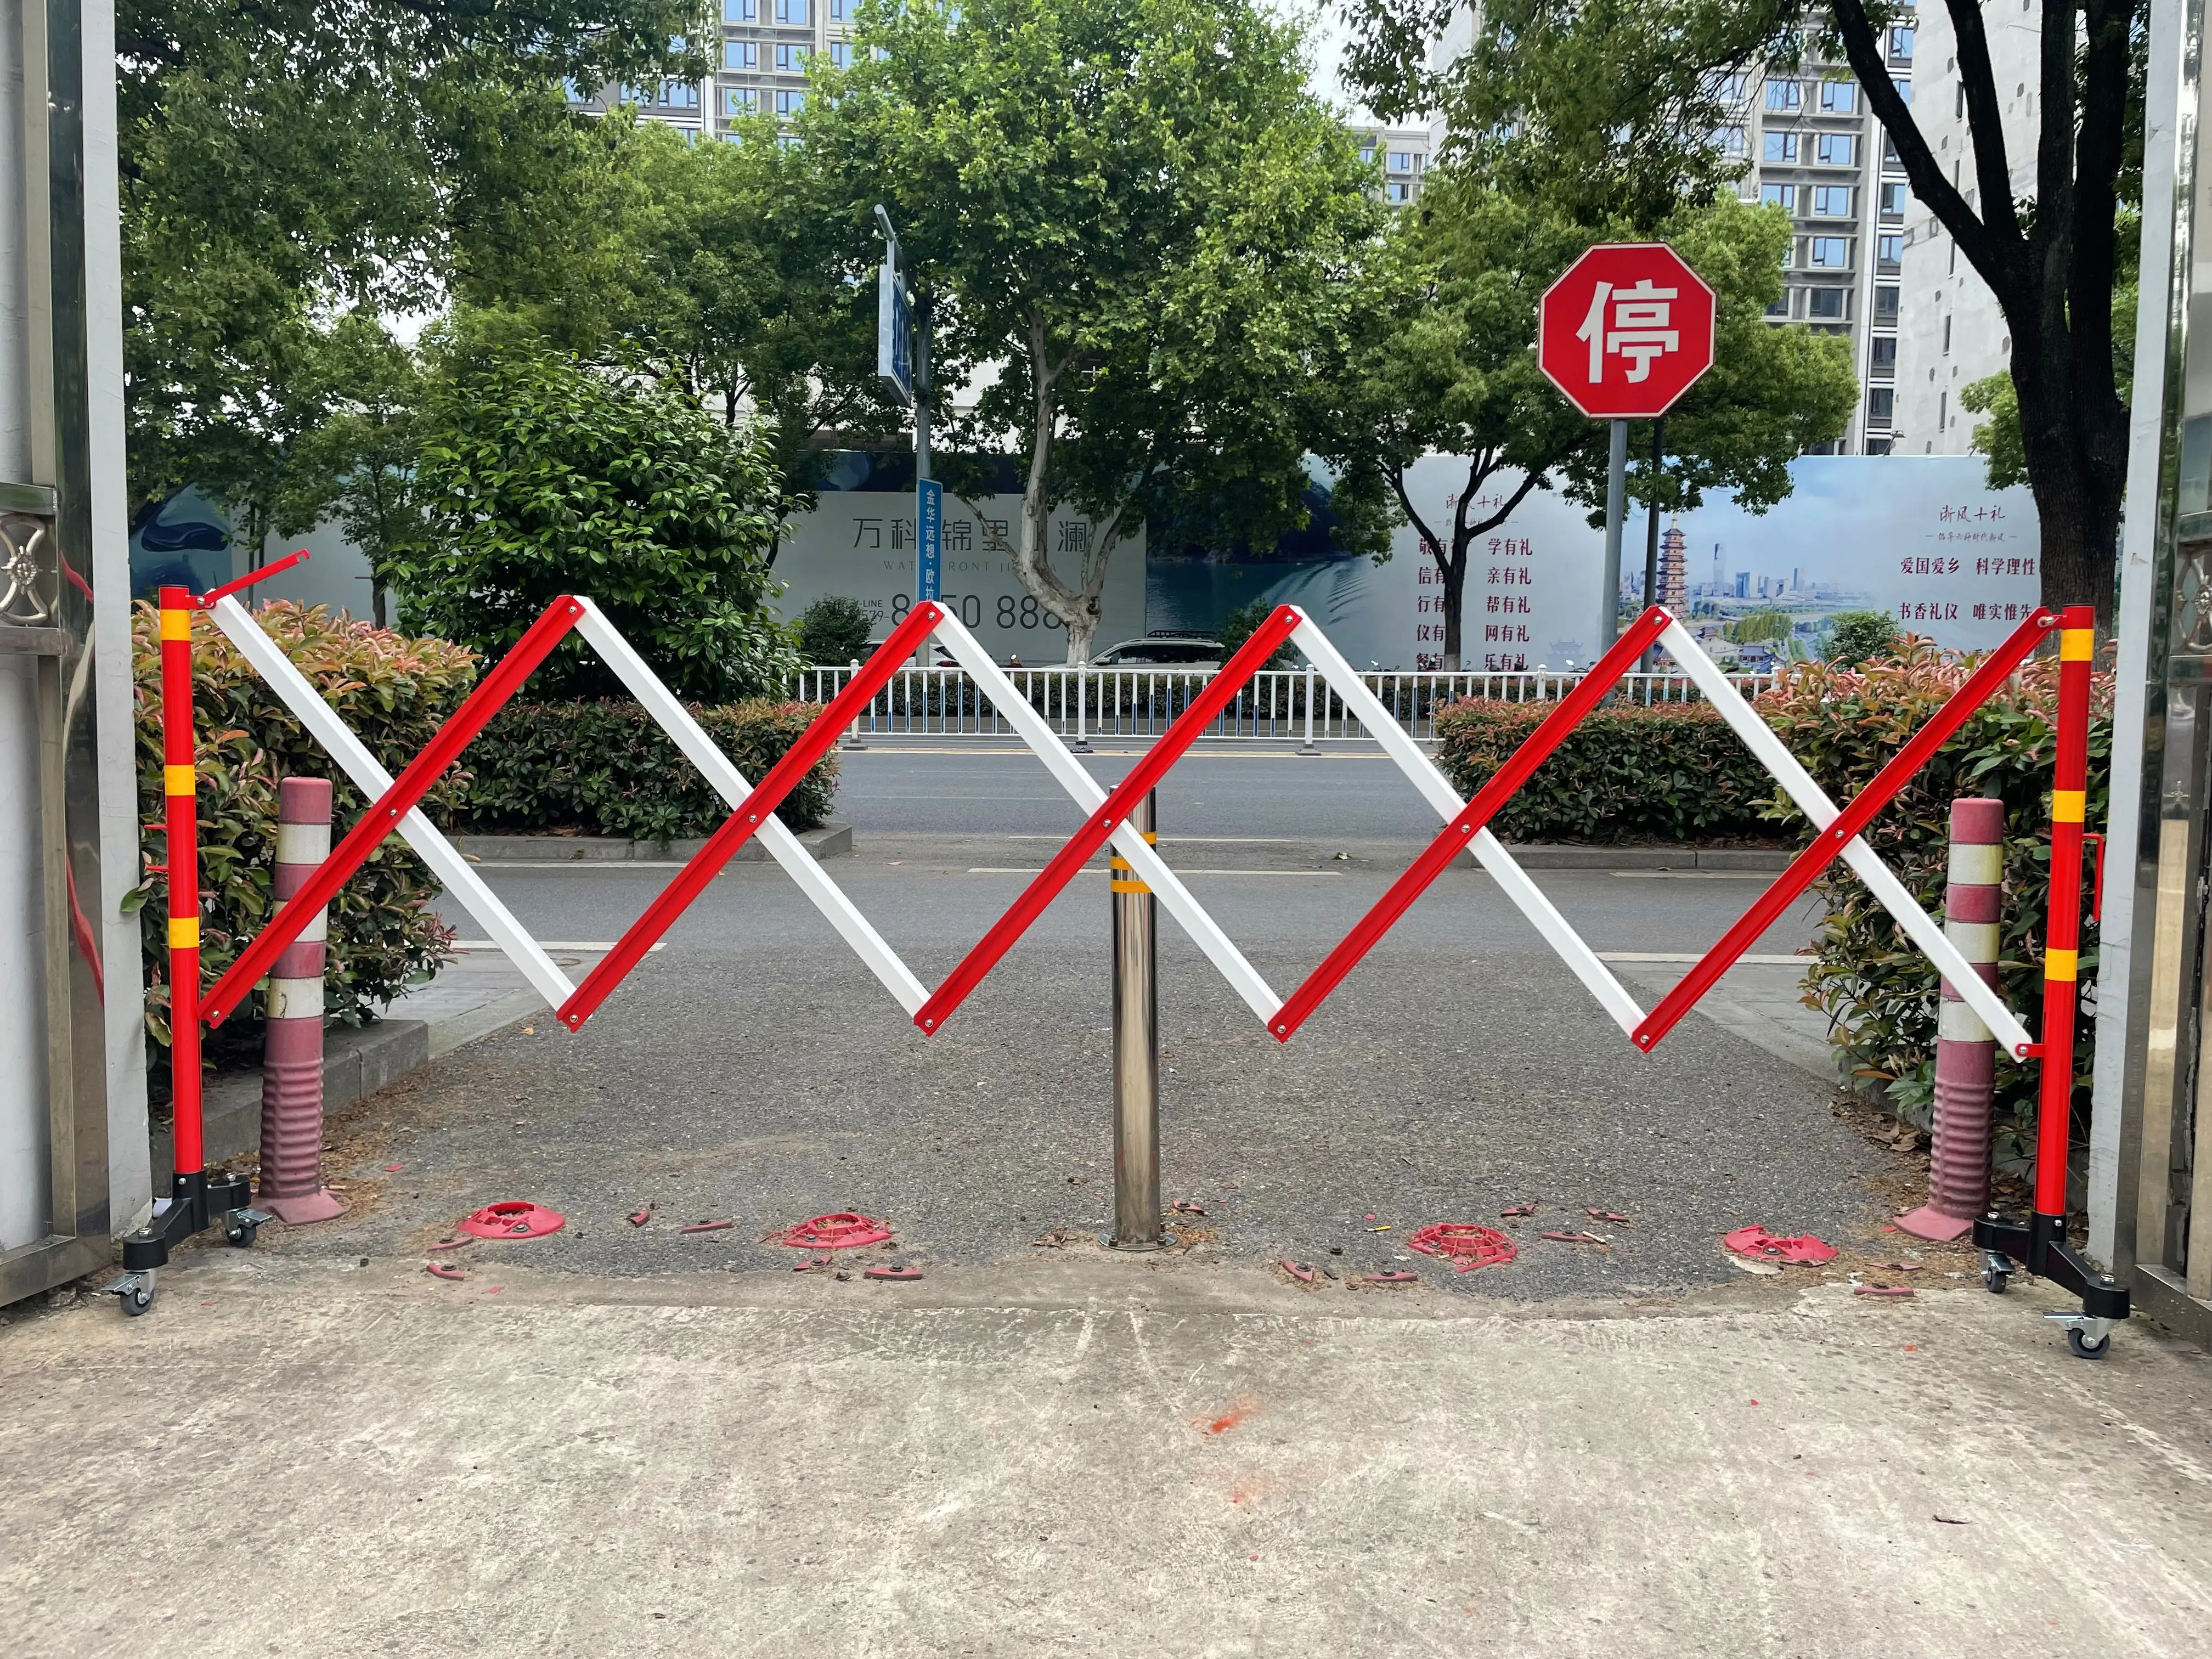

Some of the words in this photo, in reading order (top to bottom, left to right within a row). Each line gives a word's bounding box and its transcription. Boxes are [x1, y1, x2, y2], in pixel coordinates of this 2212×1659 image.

[1575, 278, 1679, 384] 停
[1939, 504, 2006, 523] 浙风十礼
[1487, 538, 1533, 556] 学有礼
[1900, 556, 1960, 575] 爱国爱乡
[1976, 557, 2036, 575] 科学理性
[1487, 567, 1532, 585] 亲有礼
[1486, 595, 1531, 613] 帮有礼
[1898, 602, 1959, 620] 书香礼仪
[1485, 624, 1530, 642] 网有礼
